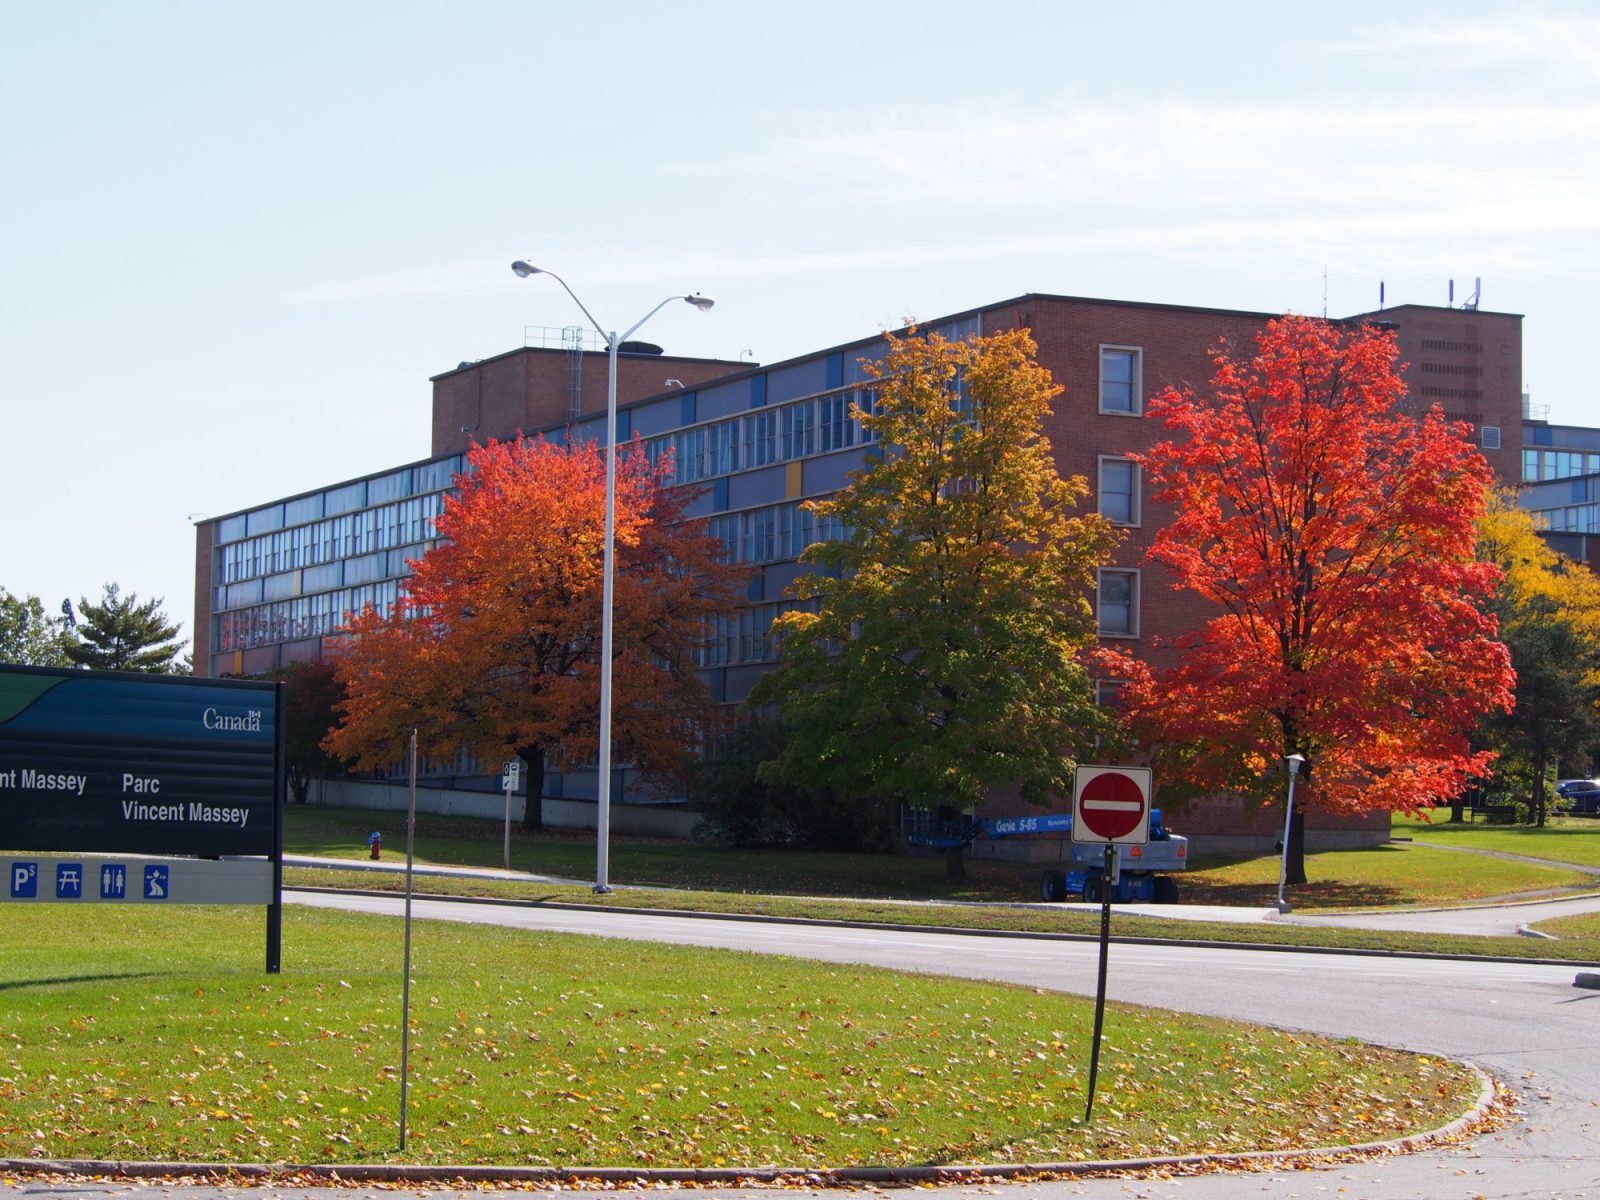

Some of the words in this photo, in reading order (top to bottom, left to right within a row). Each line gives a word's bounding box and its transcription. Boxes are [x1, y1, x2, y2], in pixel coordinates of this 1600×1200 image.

[203, 707, 261, 731] Canada
[21, 769, 87, 795] Massey
[122, 773, 160, 793] Parc
[122, 801, 184, 821] Vincent
[189, 803, 249, 827] Massey
